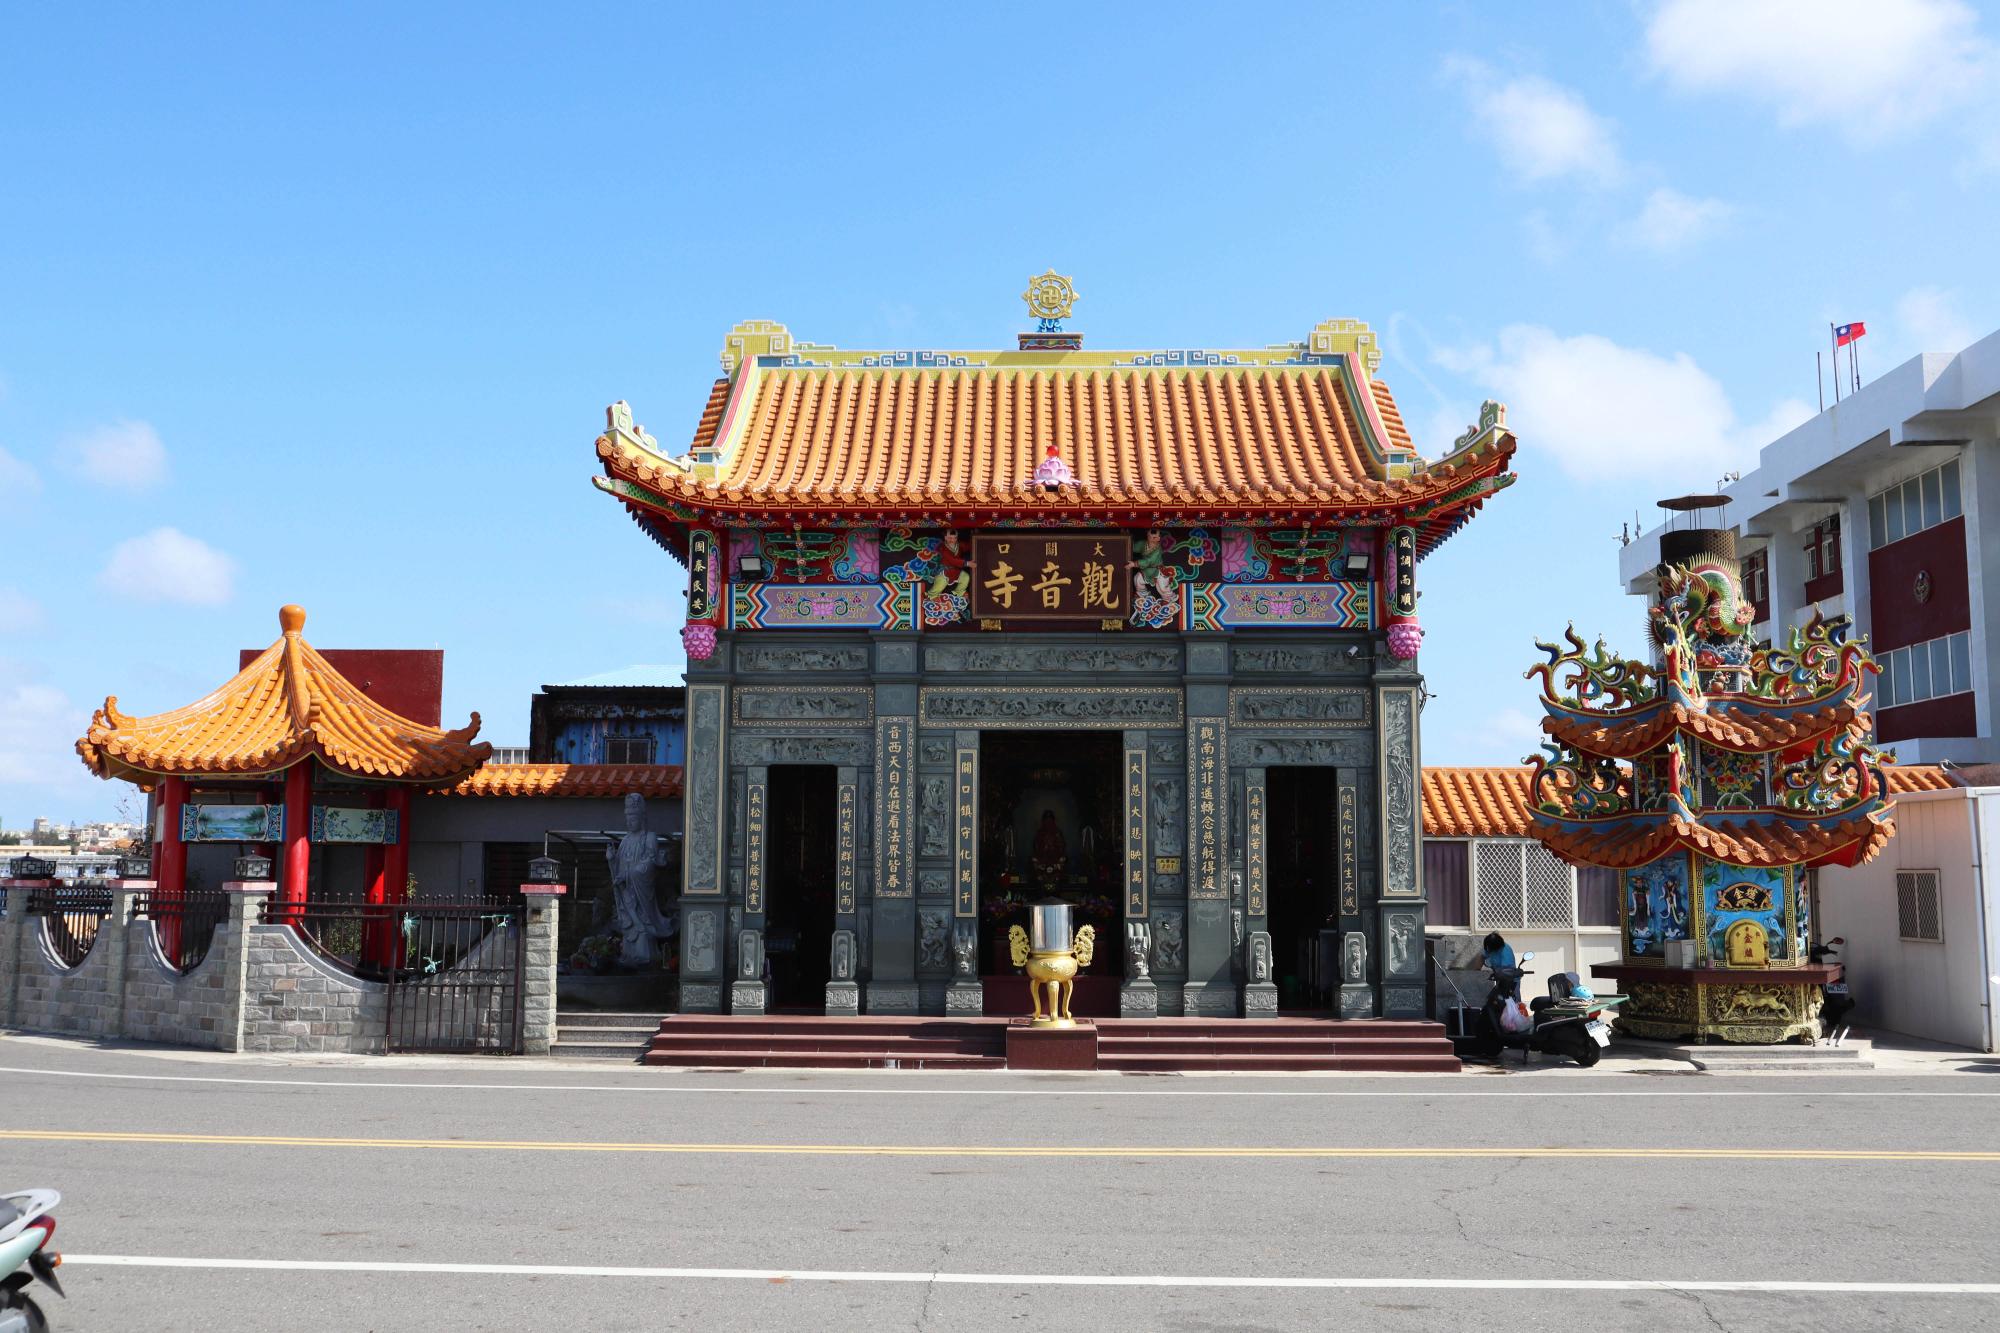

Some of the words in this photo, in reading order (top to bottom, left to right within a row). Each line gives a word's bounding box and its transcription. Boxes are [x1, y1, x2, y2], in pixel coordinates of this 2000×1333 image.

[691, 540, 706, 610] 國泰民安
[983, 560, 1120, 610] 觀音寺
[1400, 535, 1412, 606] 風調雨順
[1129, 762, 1143, 906] 大慈大悲映萬民
